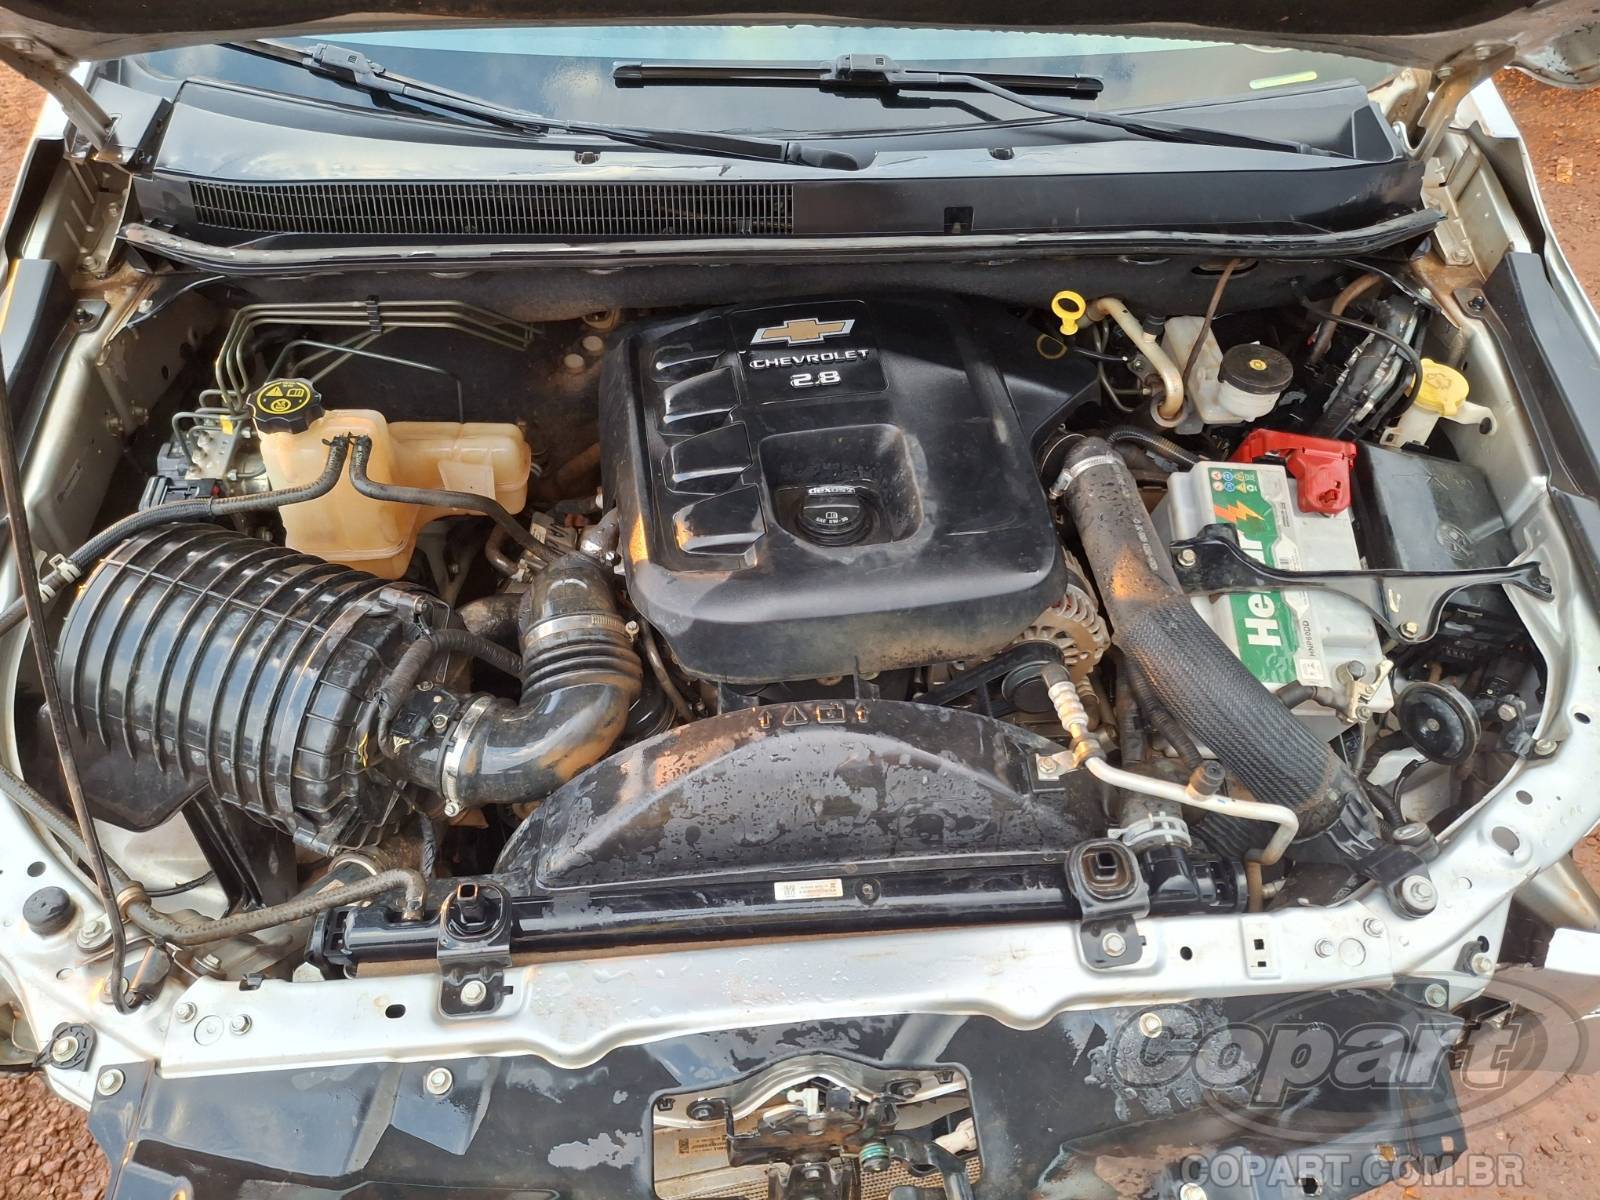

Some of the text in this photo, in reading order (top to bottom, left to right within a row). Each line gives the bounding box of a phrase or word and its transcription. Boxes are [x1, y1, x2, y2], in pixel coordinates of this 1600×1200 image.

[750, 350, 869, 369] CHEVROLET
[790, 370, 841, 388] 2.8
[1237, 529, 1282, 647] Her
